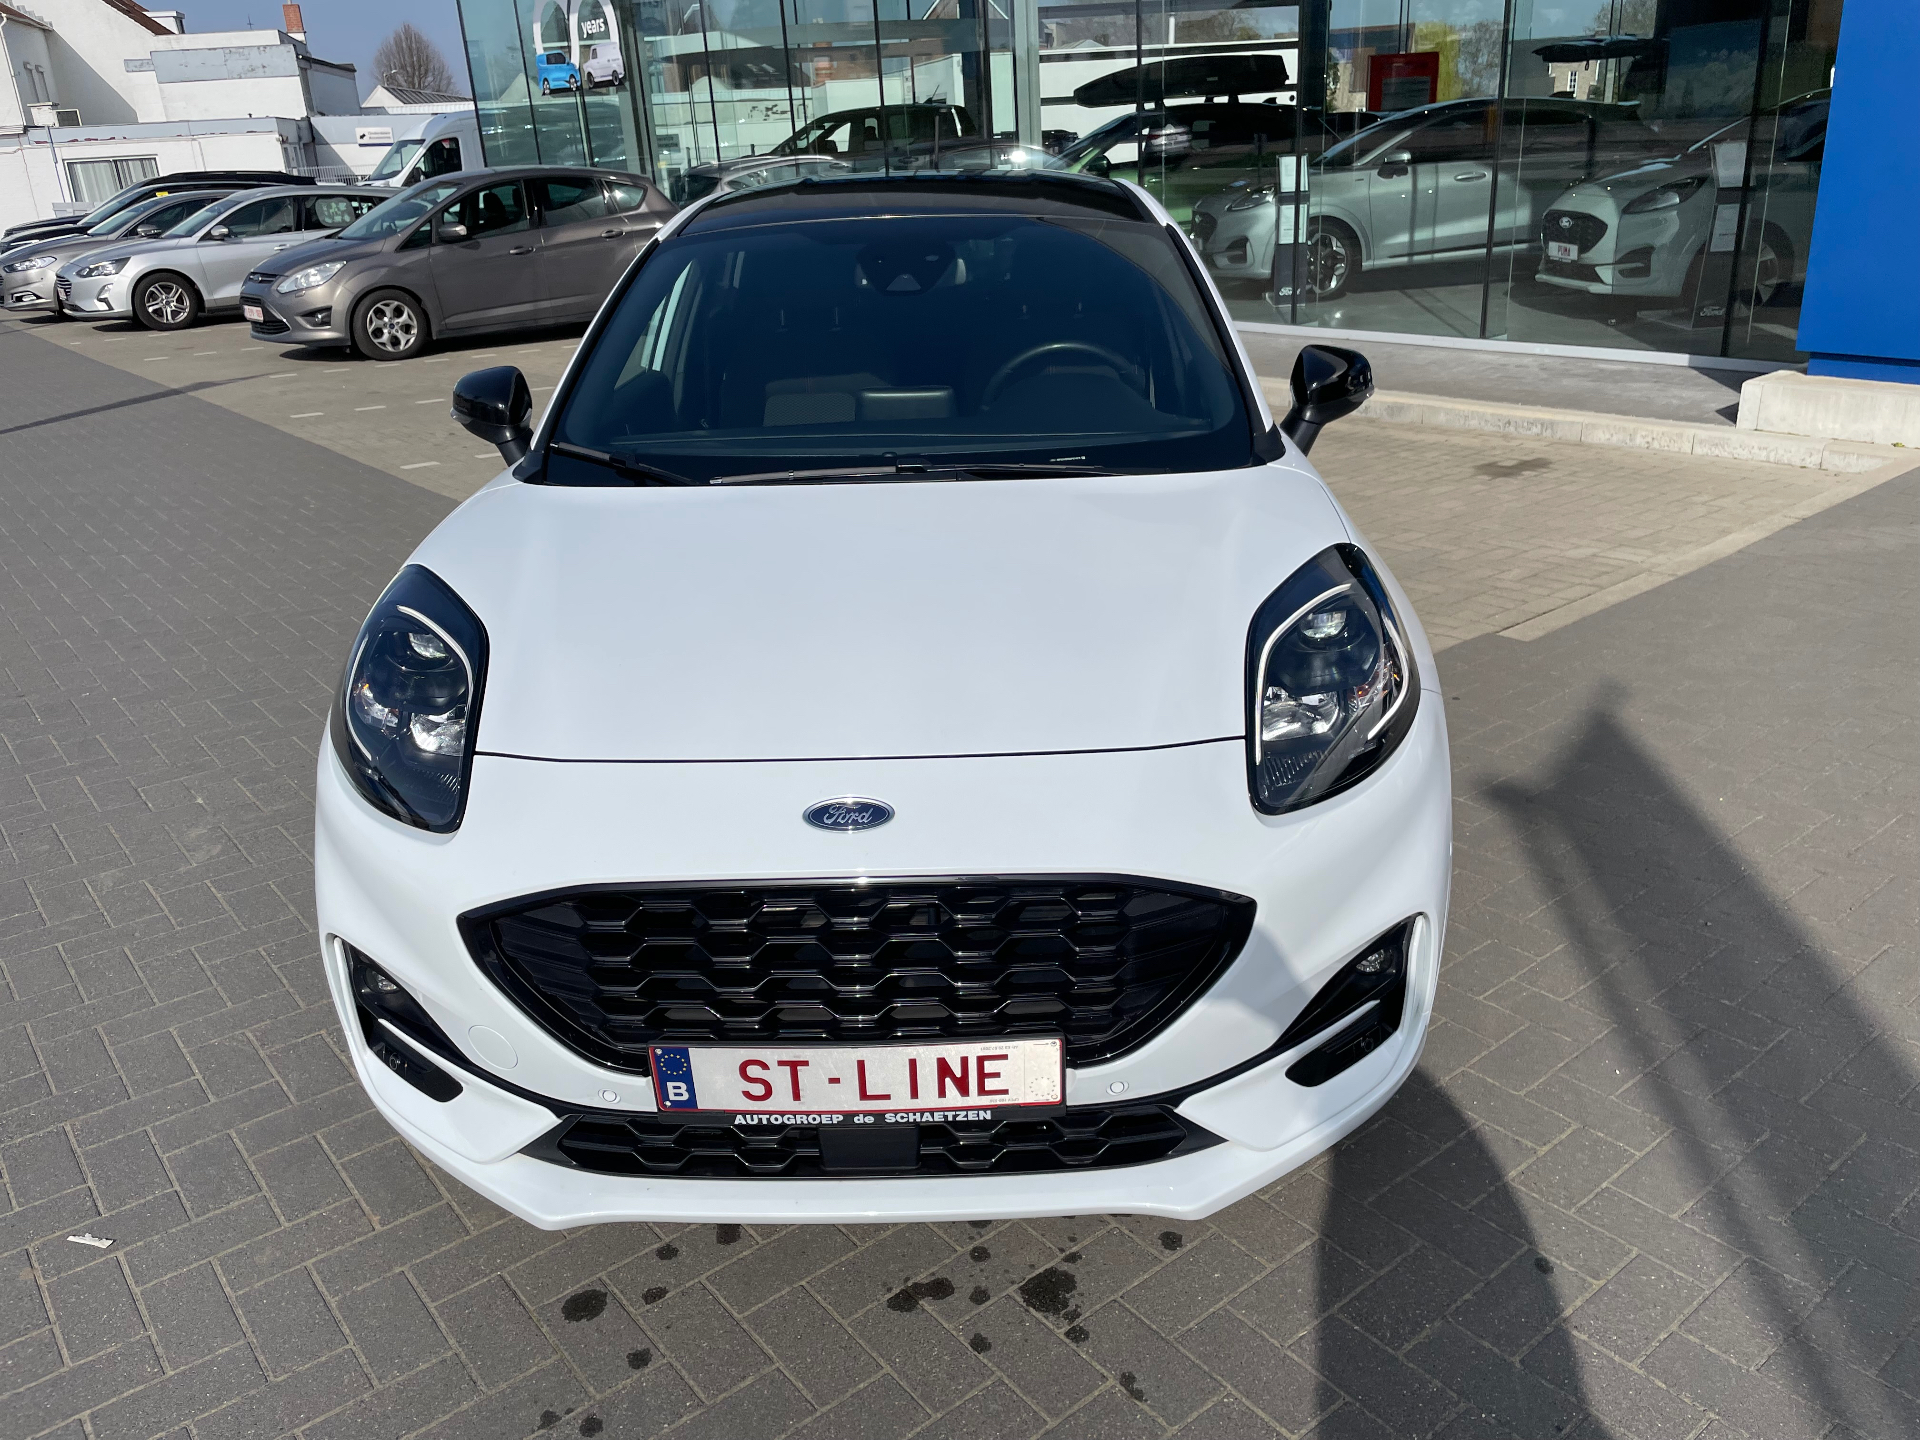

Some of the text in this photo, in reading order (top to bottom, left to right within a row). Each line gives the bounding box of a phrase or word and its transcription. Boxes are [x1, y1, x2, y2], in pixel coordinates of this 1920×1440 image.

[581, 17, 605, 39] years
[823, 803, 874, 824] Ford
[666, 1081, 689, 1101] B
[734, 1110, 992, 1125] AUTOGROEP de SCHAETZEN
